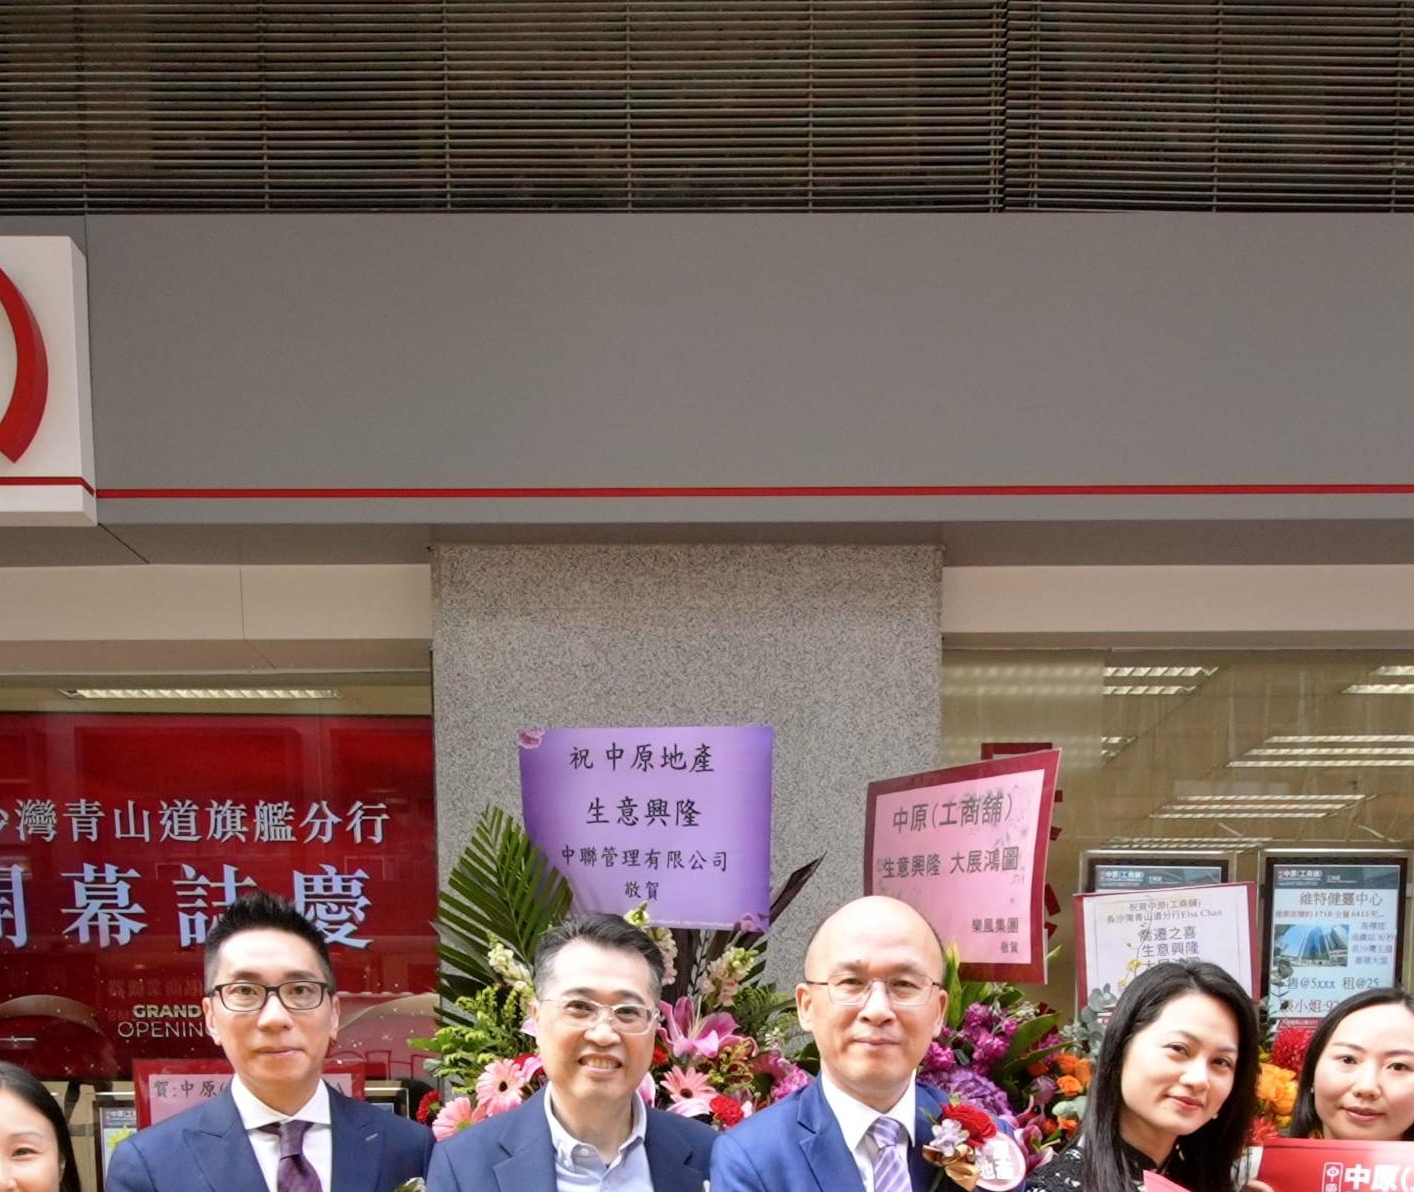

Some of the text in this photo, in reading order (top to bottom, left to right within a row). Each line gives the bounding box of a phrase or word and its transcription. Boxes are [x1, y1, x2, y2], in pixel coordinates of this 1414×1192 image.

[570, 741, 716, 774] 祝 中原地產
[585, 796, 702, 829] 生意興隆
[561, 846, 730, 873] 中聯管理有限公司
[883, 847, 1019, 879] 生意興隆 大展鴻圖
[624, 879, 660, 901] 敬賀
[1142, 941, 1200, 958] 生意興隆
[133, 1004, 202, 1018] GRAND
